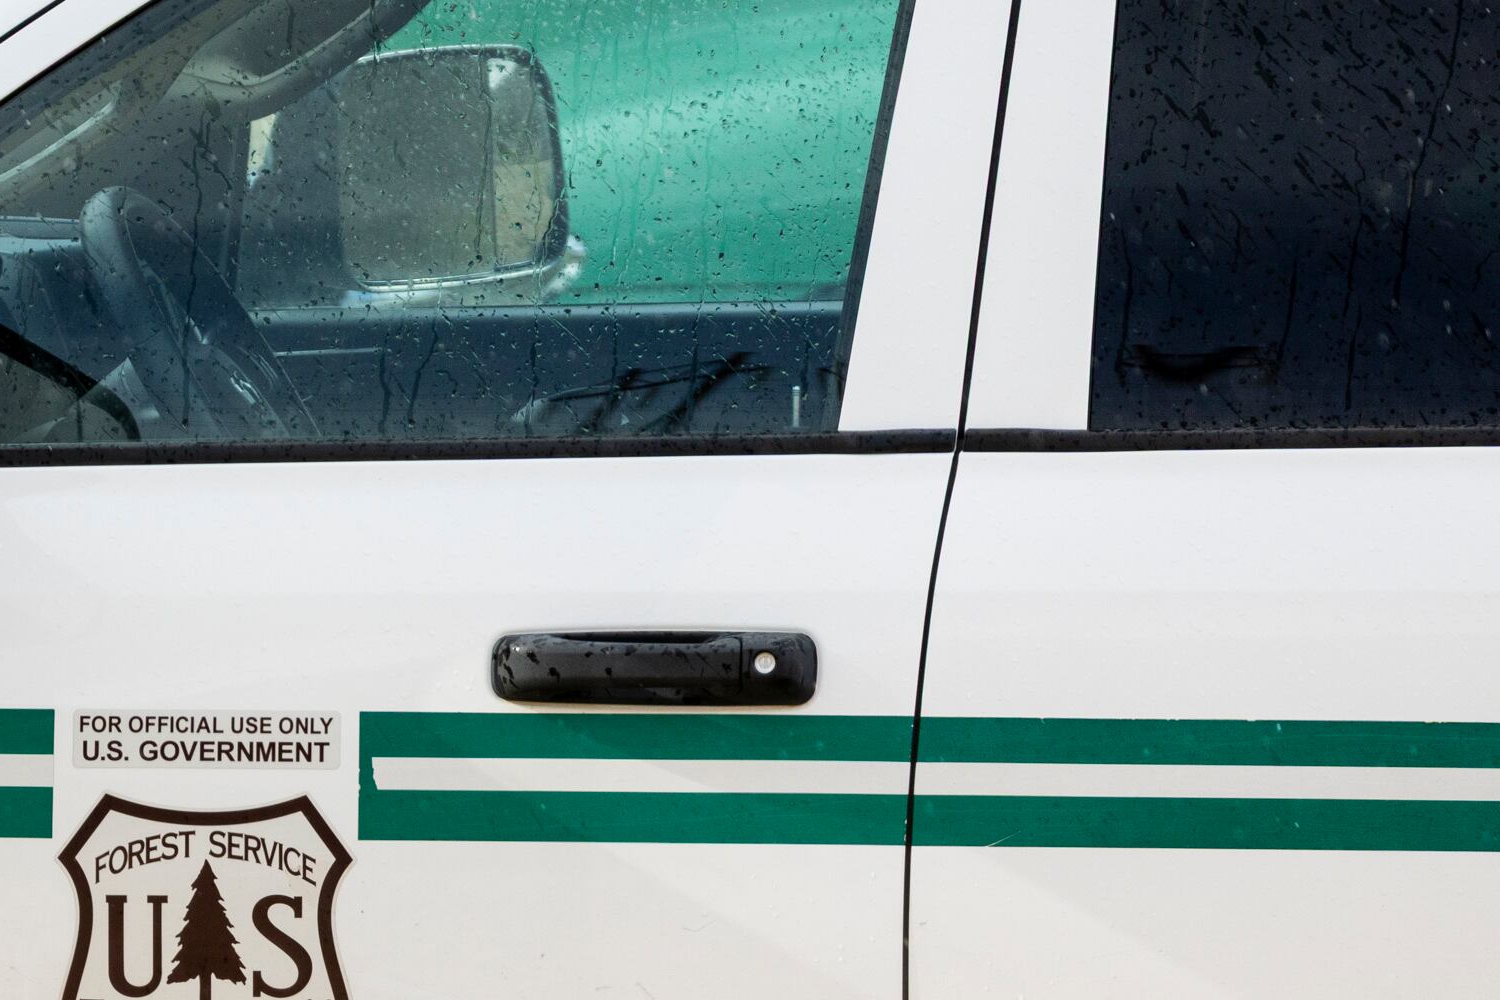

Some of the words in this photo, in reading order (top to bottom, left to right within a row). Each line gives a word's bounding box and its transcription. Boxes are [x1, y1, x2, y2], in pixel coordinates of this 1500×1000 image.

[78, 715, 122, 734] FOR
[128, 716, 224, 735] OFFICIAL
[230, 717, 272, 735] USE
[278, 717, 334, 735] ONLY
[82, 740, 130, 762] U.S.
[139, 740, 330, 763] GOVERNMENT
[94, 830, 196, 885] FOREST
[208, 830, 318, 887] SERVICE
[105, 894, 169, 998] U
[251, 895, 313, 999] S
